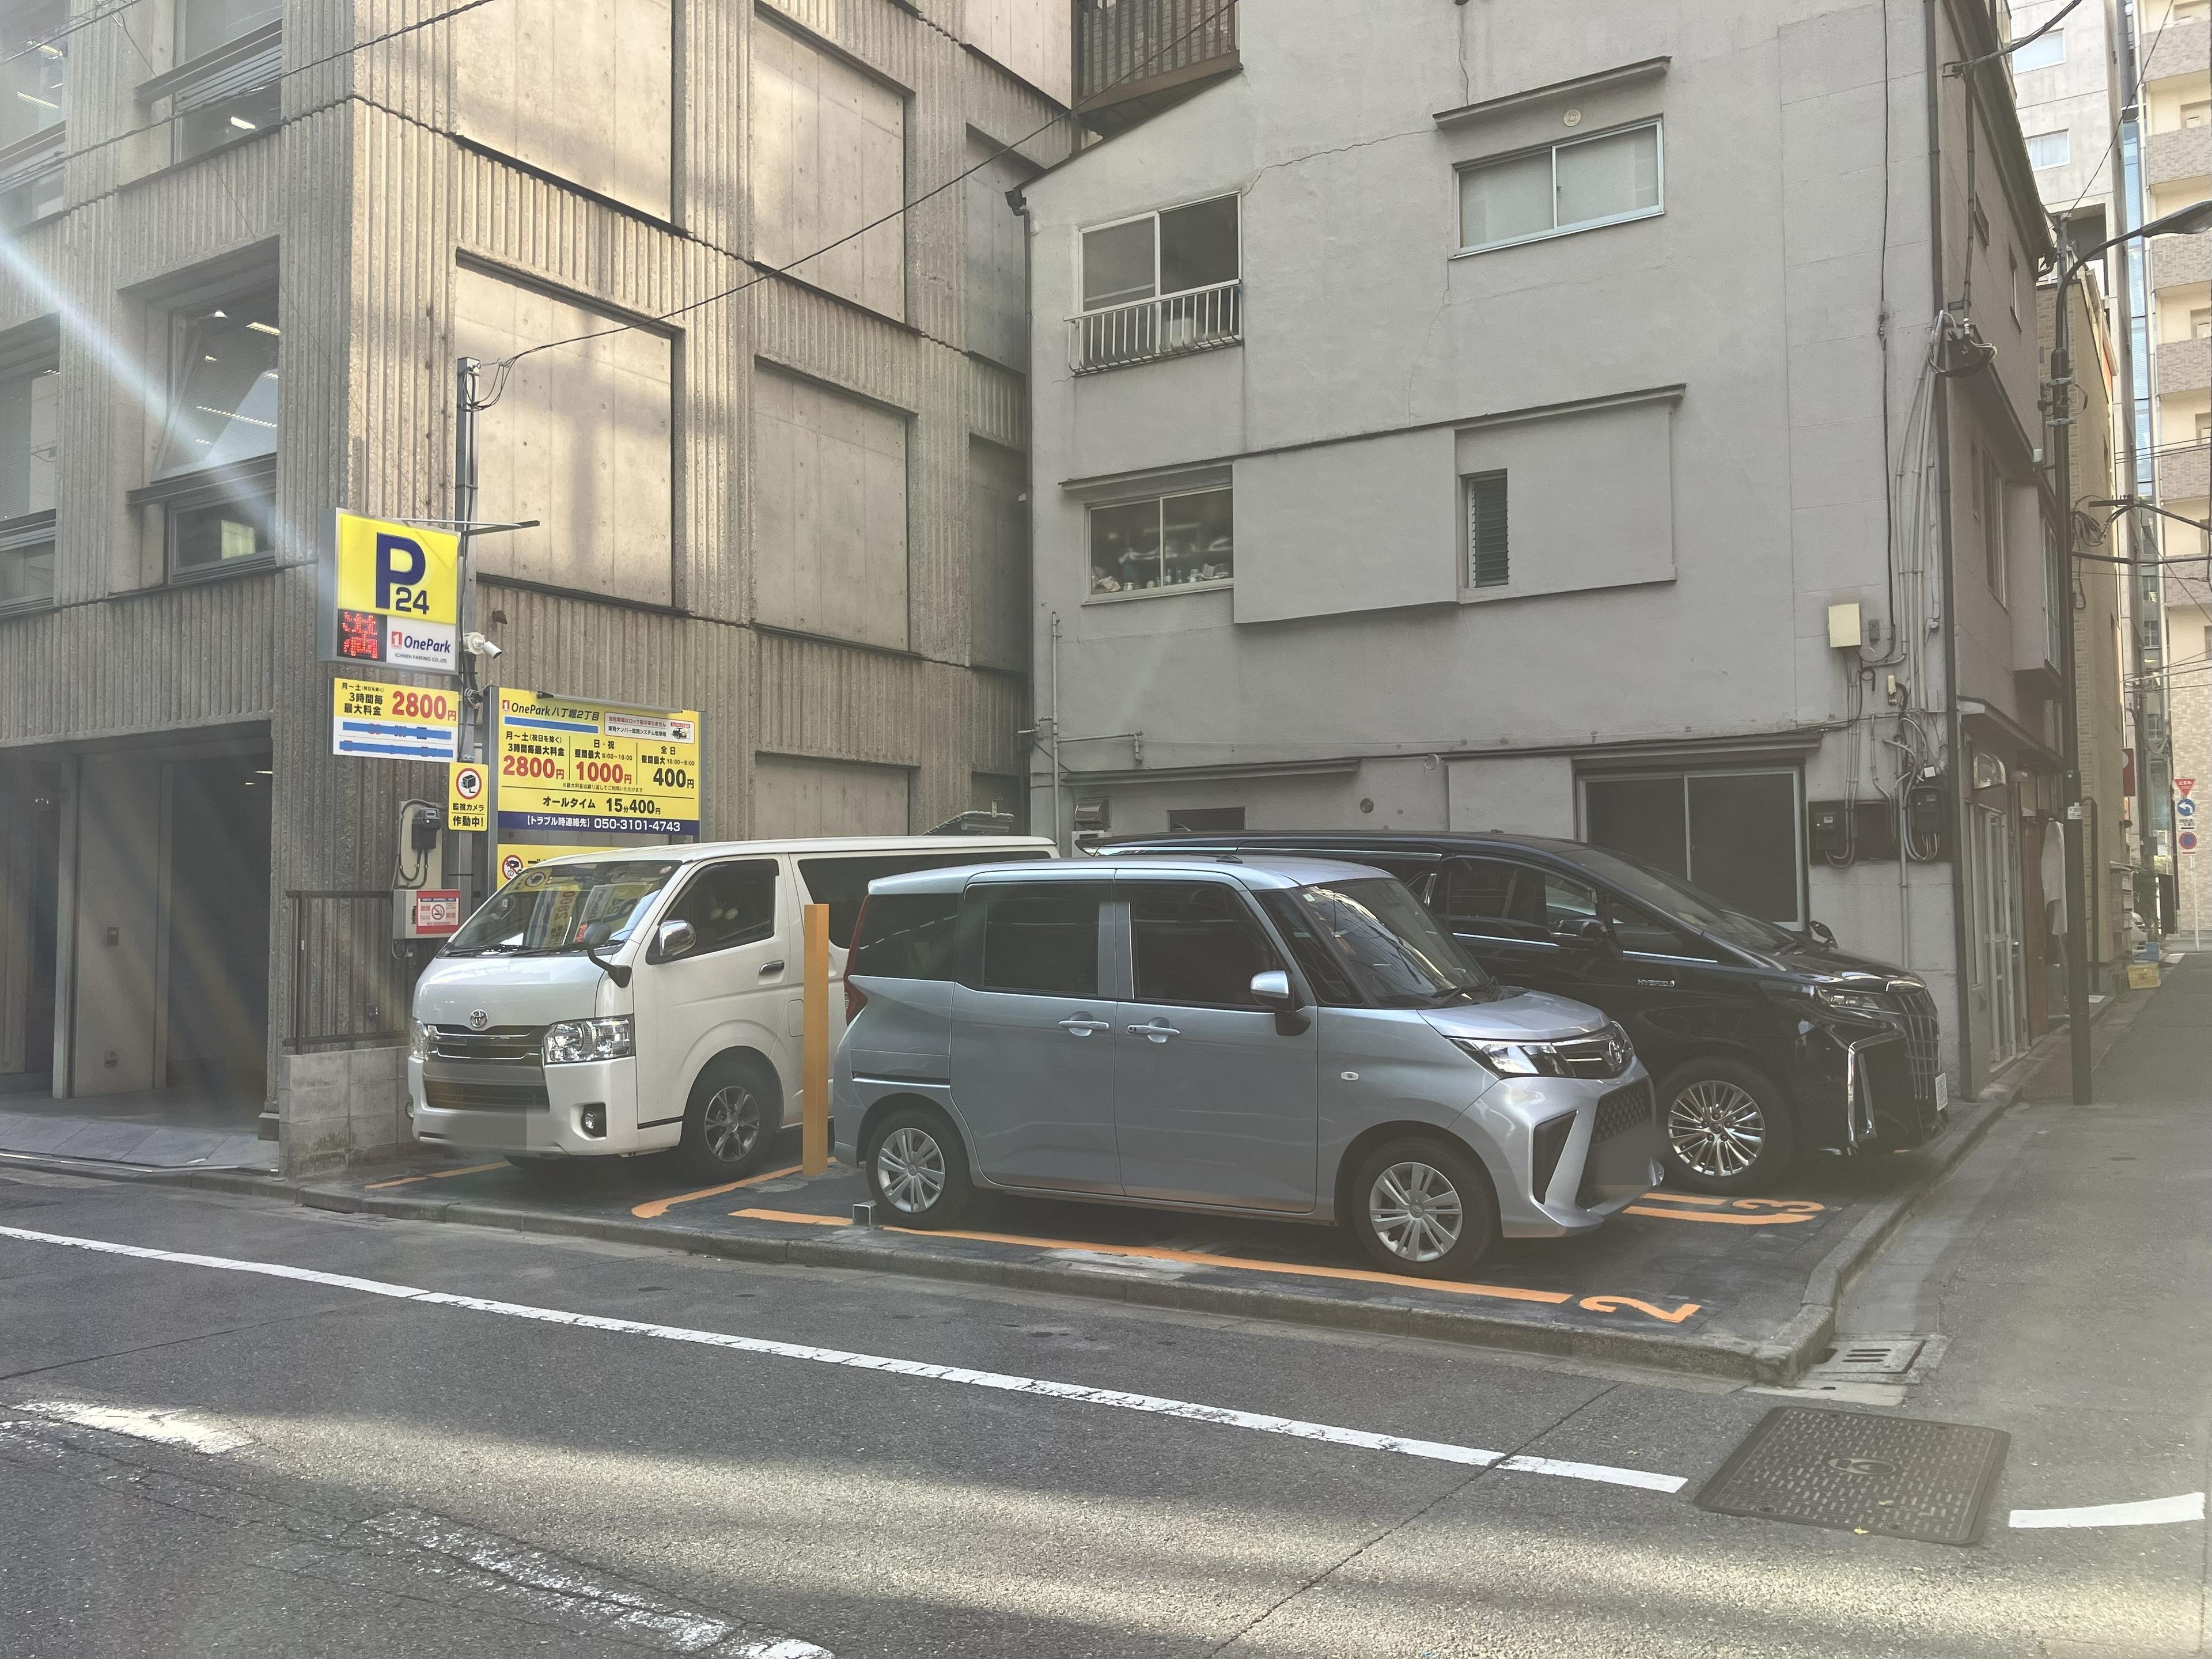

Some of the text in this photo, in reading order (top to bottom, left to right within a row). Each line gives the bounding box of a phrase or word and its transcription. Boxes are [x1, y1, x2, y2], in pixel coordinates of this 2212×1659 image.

[376, 532, 426, 609] P
[395, 586, 430, 615] 24
[404, 635, 451, 653] OnePark
[349, 692, 383, 705] 3時間毎
[392, 691, 457, 721] 2800円
[344, 703, 381, 716] 最大料金
[512, 702, 550, 717] OnePark
[551, 707, 600, 721] 八丁堀2丁目
[507, 743, 565, 756] 3時間毎最大料金
[574, 748, 600, 760] 昼間最大
[503, 755, 565, 780] 2800円
[641, 755, 665, 765] 夜間最大
[576, 761, 632, 785] 1000円
[653, 767, 695, 789] 400円
[452, 802, 484, 812] 監視カメラ
[543, 796, 596, 809] オールタイム
[594, 817, 681, 832] 050-3101-4743
[1579, 1296, 1701, 1323] 2
